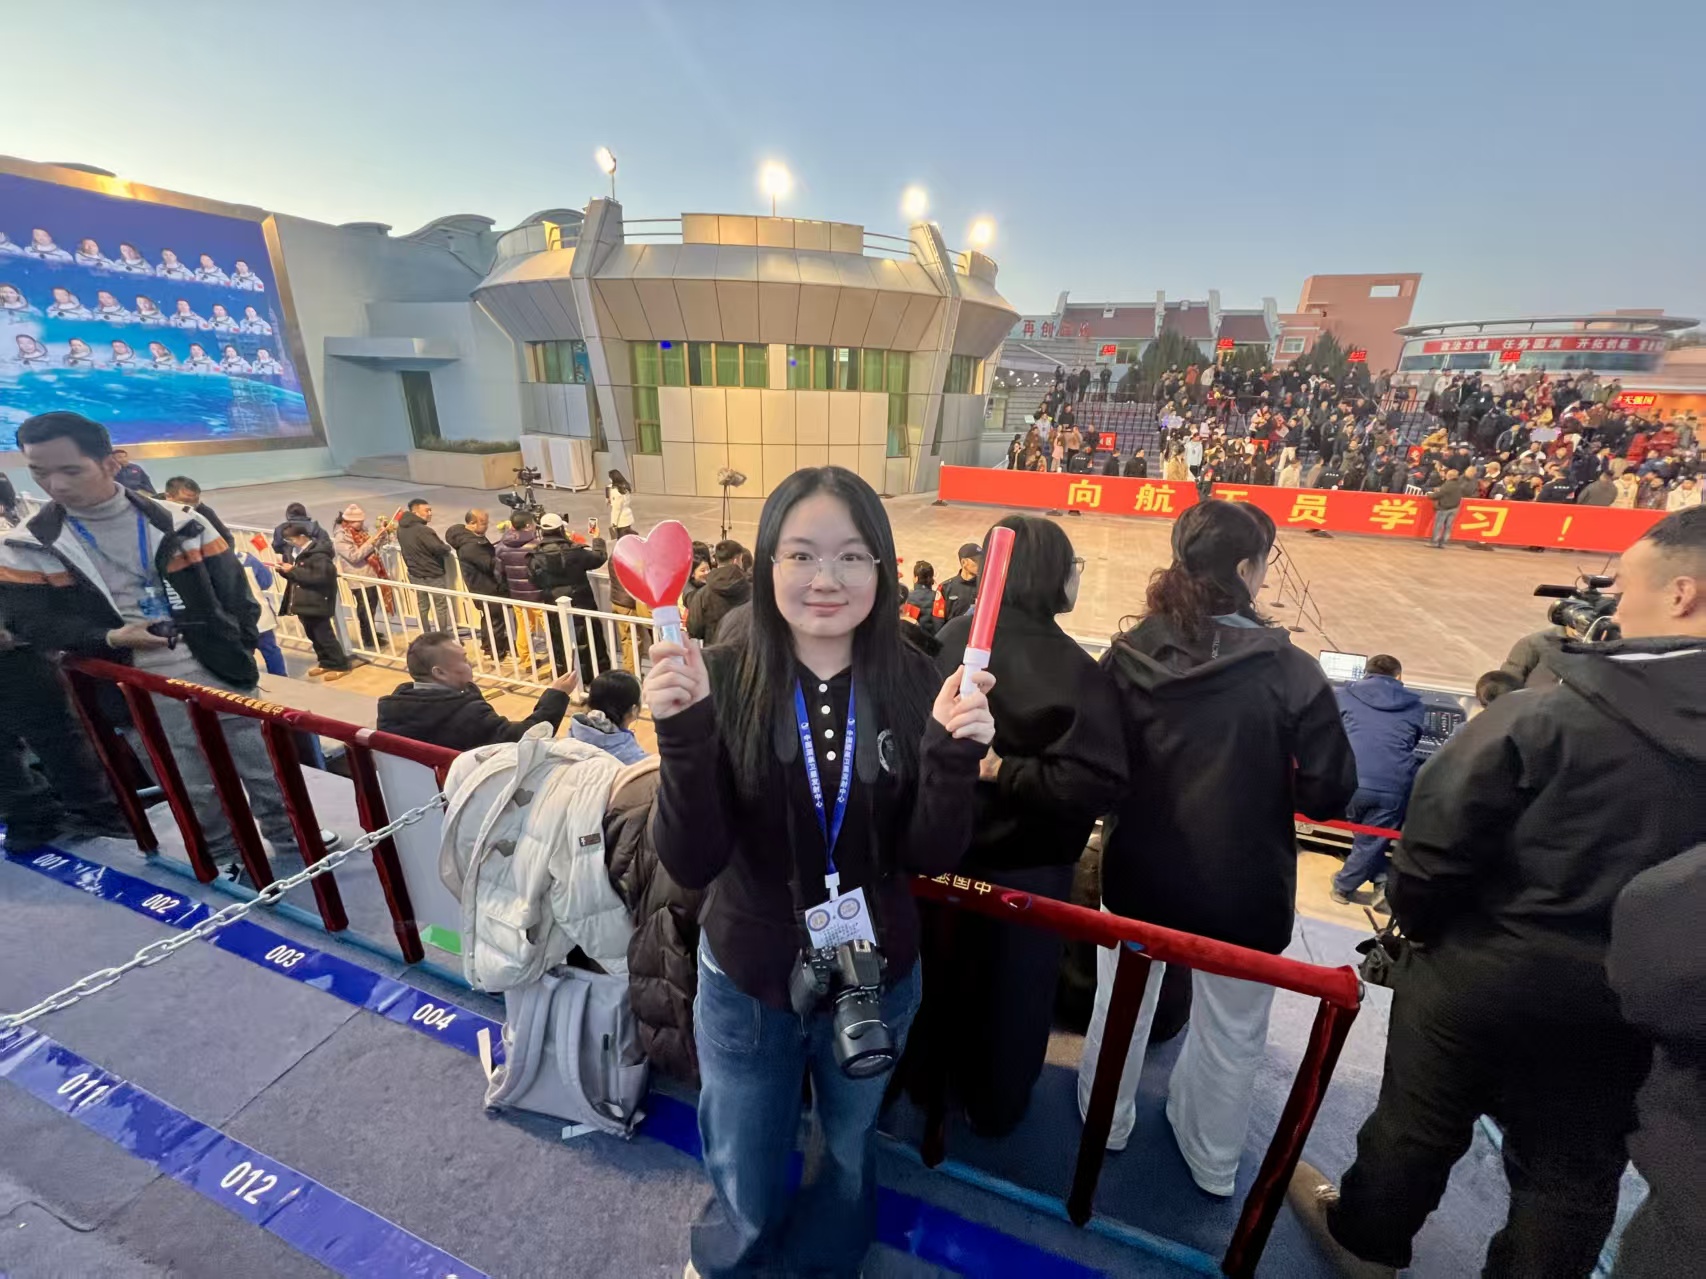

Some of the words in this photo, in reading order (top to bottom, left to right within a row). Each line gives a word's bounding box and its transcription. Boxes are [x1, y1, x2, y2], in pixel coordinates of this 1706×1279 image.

[32, 853, 70, 870] 001
[141, 893, 181, 914] 002
[264, 944, 306, 968] 003
[412, 1003, 457, 1031] 004
[57, 1072, 110, 1107] 011
[220, 1161, 278, 1205] 012
